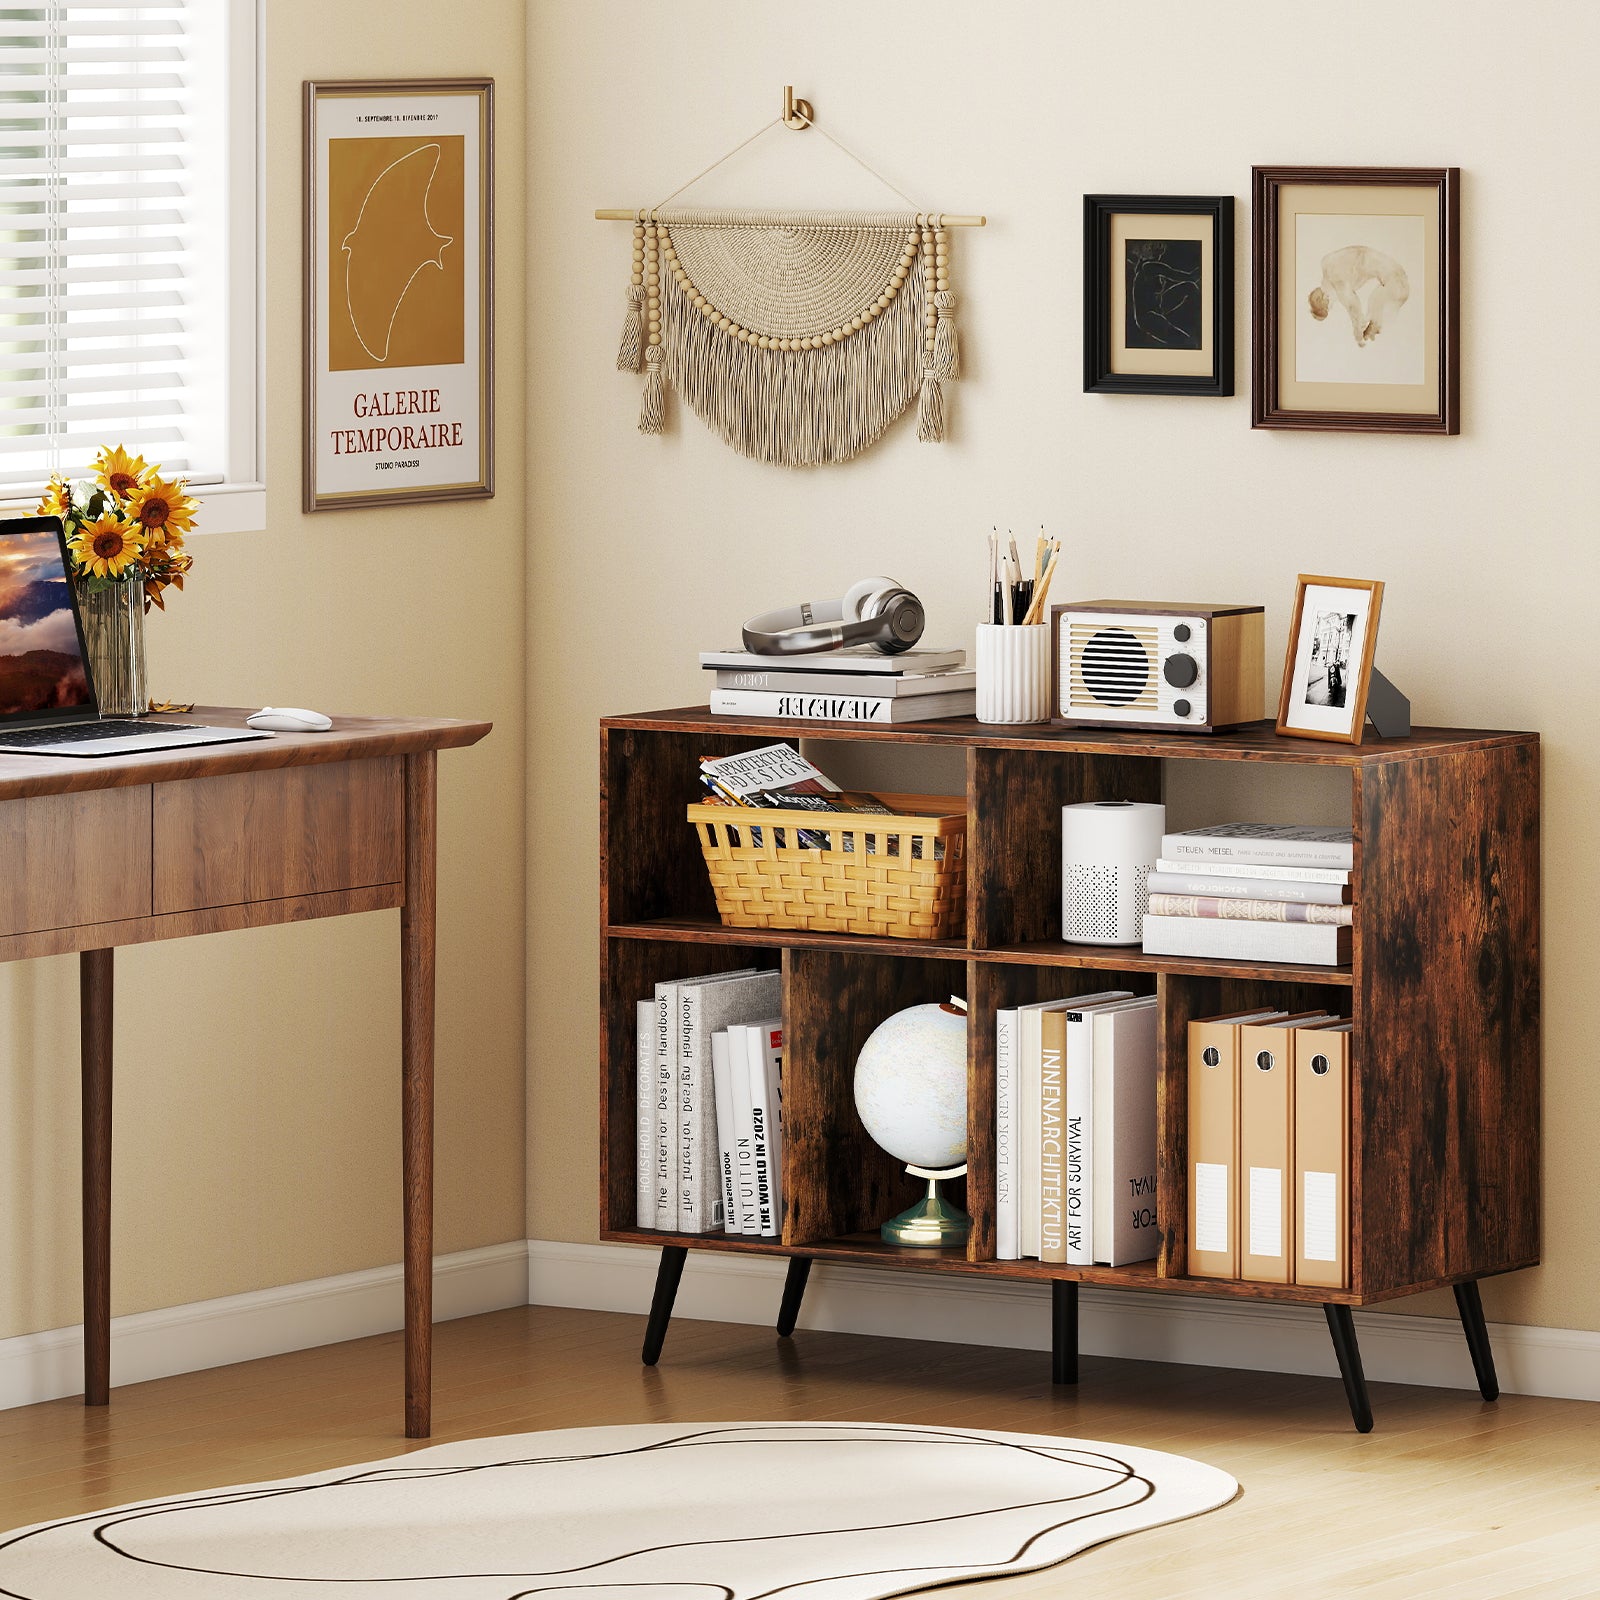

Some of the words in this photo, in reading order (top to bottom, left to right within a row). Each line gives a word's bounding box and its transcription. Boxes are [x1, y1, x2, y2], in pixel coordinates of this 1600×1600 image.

[353, 389, 441, 418] GALERIE
[330, 422, 463, 455] TEMPORAIRE
[375, 461, 394, 470] STUDIO
[714, 748, 800, 776] АРХИТЕКТУРА
[730, 759, 811, 787] DESIGN
[657, 994, 667, 1056] Handbook
[640, 1032, 650, 1108] DECORATES
[657, 1064, 670, 1111] Design
[999, 1023, 1009, 1120] REVOLUTION
[753, 1108, 765, 1141] 2020
[640, 1117, 650, 1194] HOUSEHOLD
[657, 1118, 667, 1180] Interior
[756, 1144, 766, 1157] IN
[999, 1124, 1009, 1166] LOOK
[1042, 1049, 1061, 1250] INNENARCHITEKTUR
[1068, 1116, 1082, 1183] SURVIVAL
[657, 1187, 667, 1210] The
[737, 1138, 756, 1229] INTUITION
[757, 1159, 770, 1206] WORLD
[999, 1169, 1009, 1204] NEW
[760, 1207, 771, 1231] THE
[1068, 1187, 1082, 1217] FOR
[1068, 1222, 1082, 1250] ART
